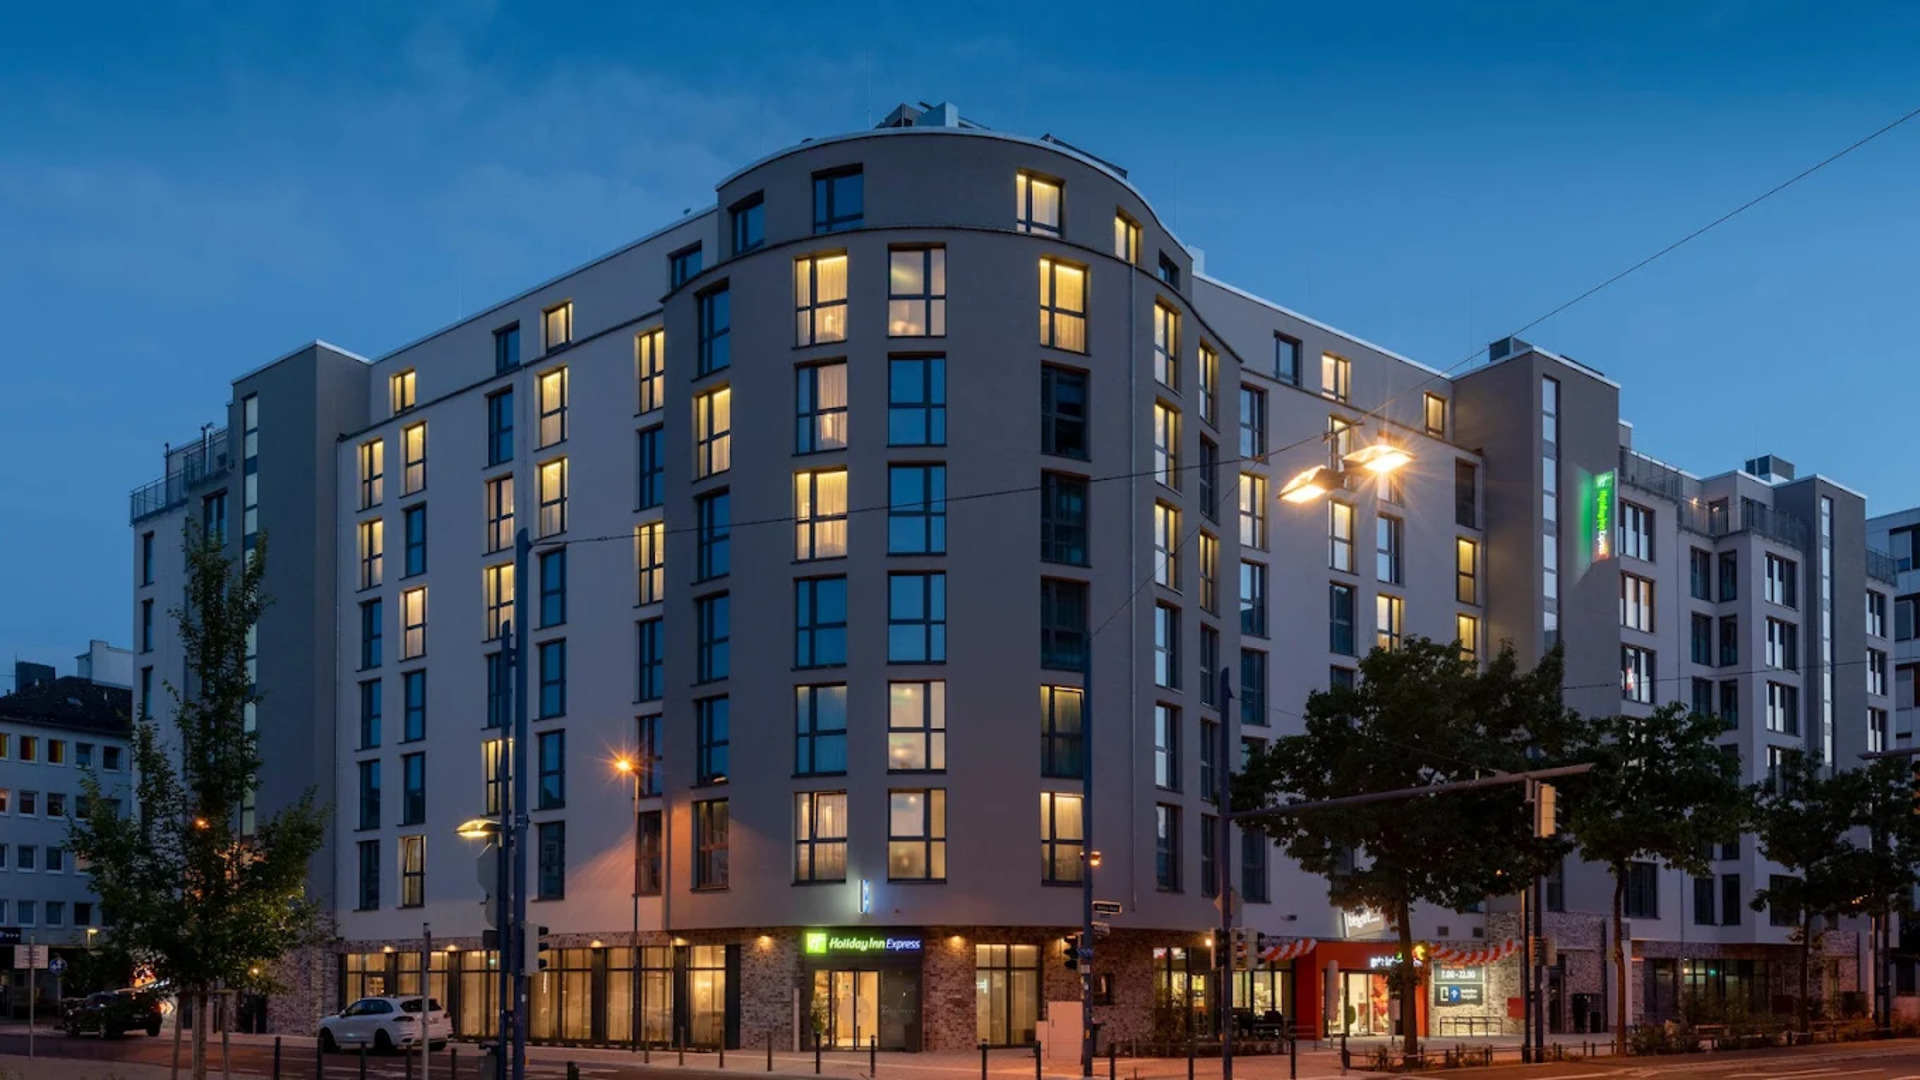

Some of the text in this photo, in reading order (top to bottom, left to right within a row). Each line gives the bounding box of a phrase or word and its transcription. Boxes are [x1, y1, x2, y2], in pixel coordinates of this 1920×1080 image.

[829, 937, 868, 951] Holiday
[869, 937, 885, 949] Inn
[886, 938, 920, 951] Express
